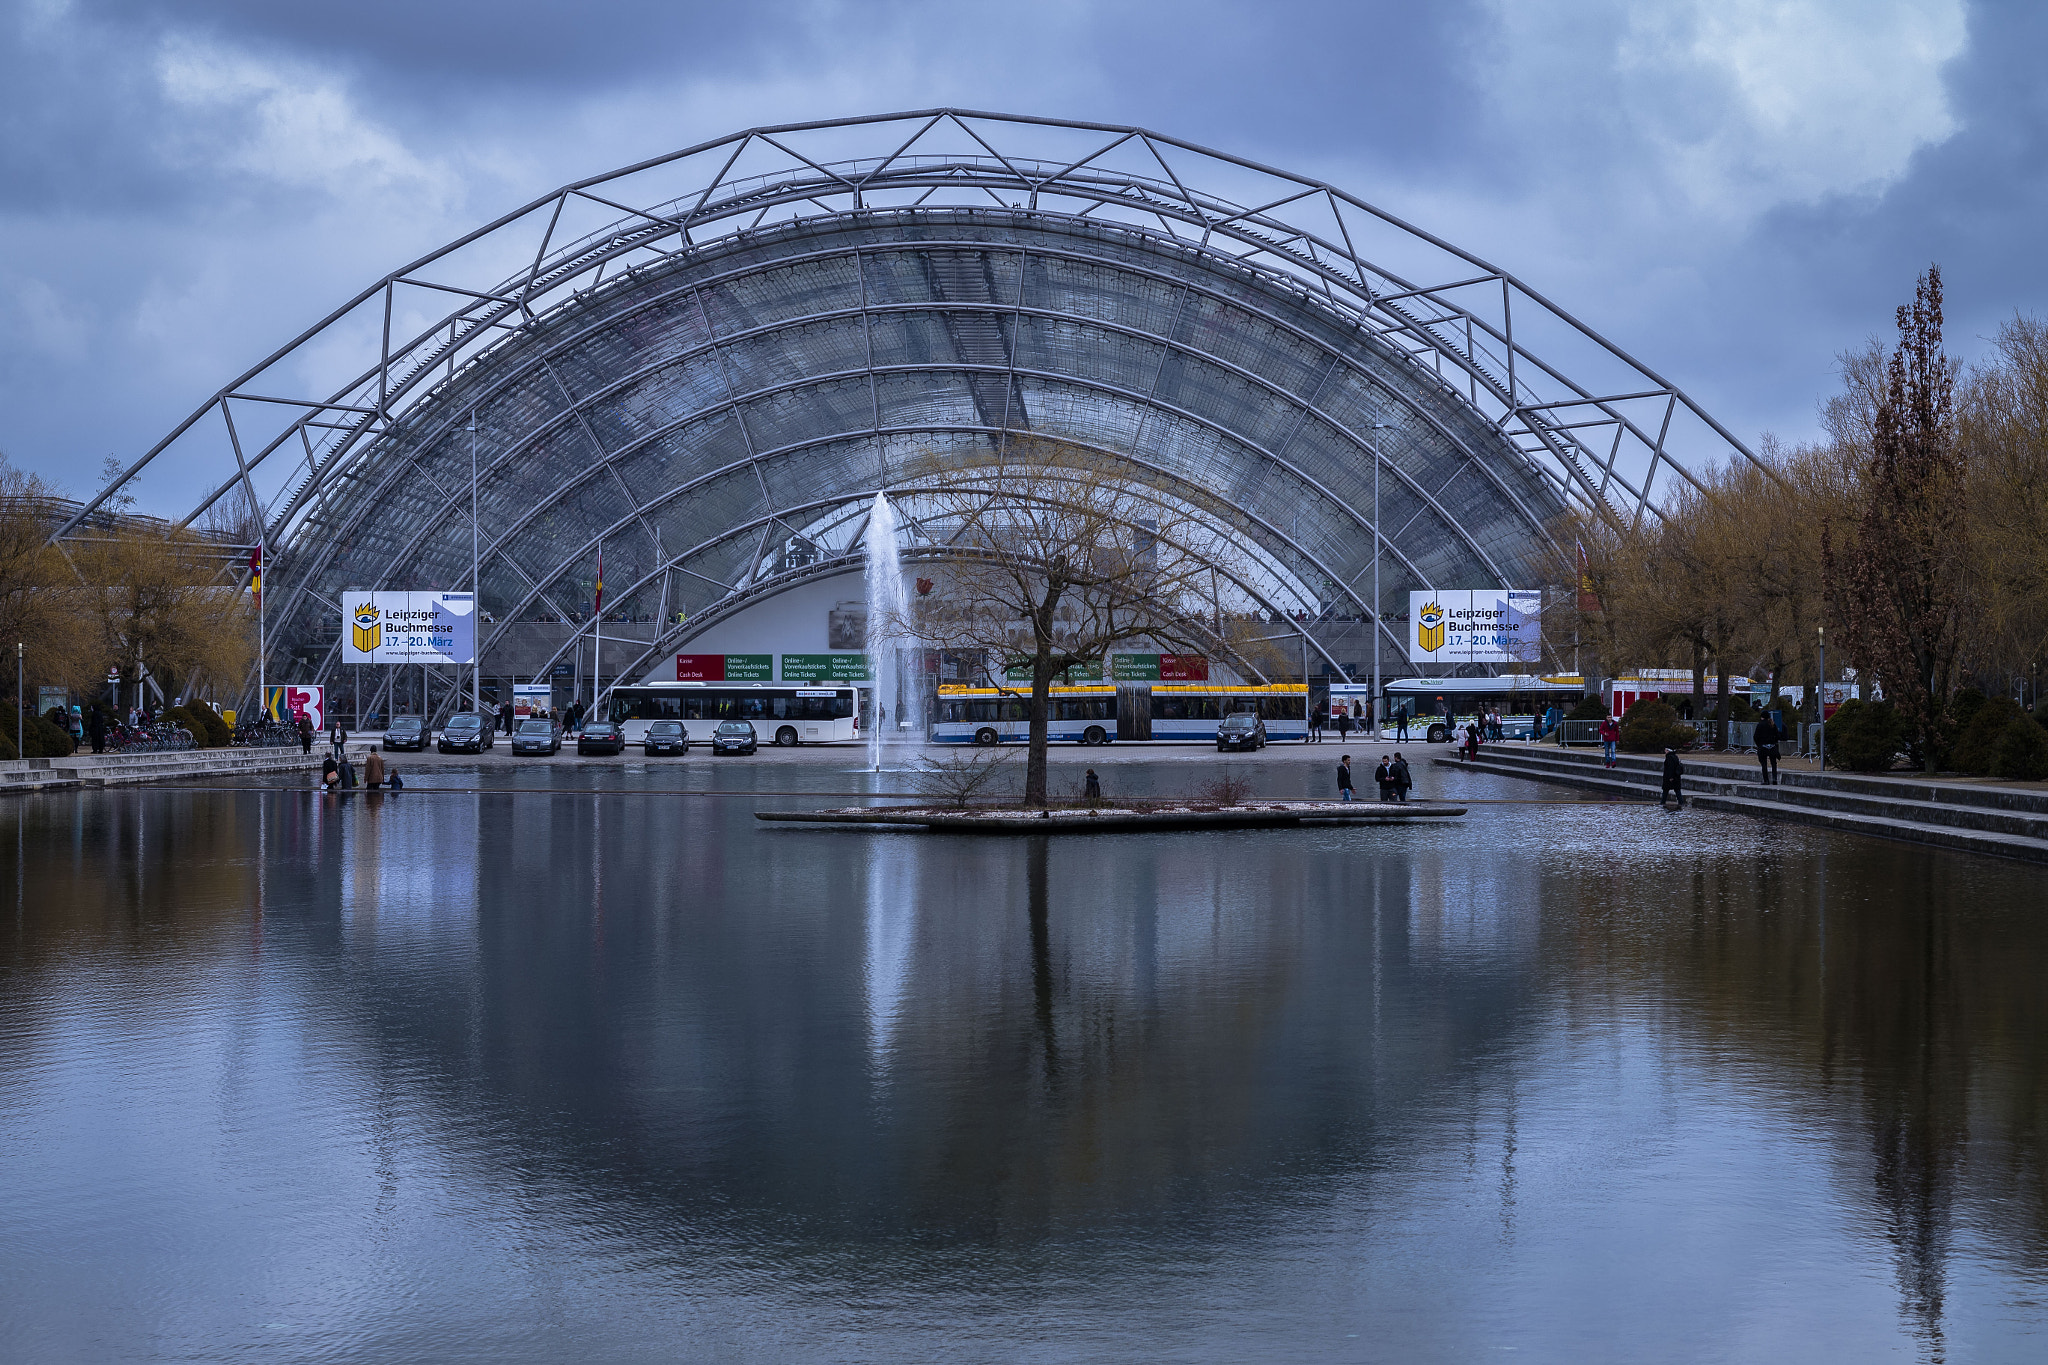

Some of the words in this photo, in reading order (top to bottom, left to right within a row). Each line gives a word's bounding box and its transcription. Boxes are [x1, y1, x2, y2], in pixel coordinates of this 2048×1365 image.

[385, 609, 440, 621] Leipziger
[1448, 608, 1505, 620] Leipziger
[385, 622, 453, 633] Buchmesse
[1448, 621, 1520, 632] Buchmesse
[427, 636, 453, 647] März
[1491, 635, 1519, 646] März
